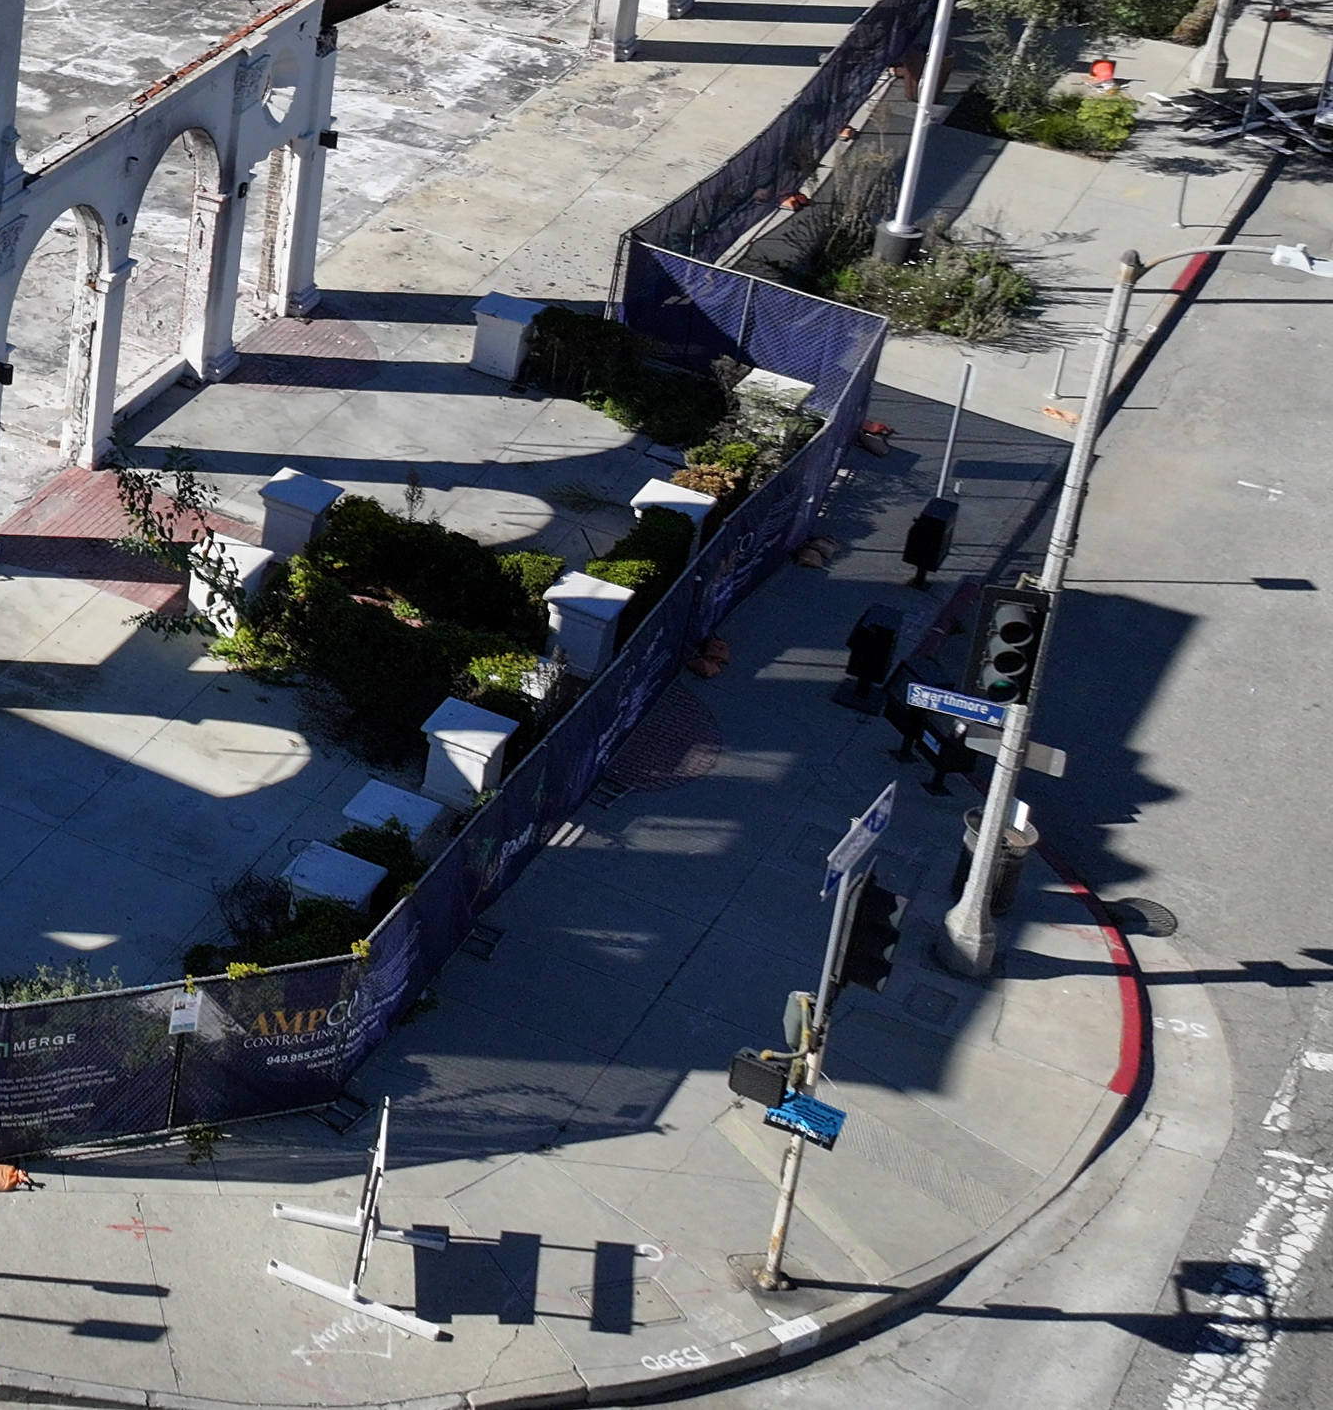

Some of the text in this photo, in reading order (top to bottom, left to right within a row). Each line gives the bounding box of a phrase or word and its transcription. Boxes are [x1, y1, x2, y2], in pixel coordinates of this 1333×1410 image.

[912, 686, 989, 714] Swarthmore
[13, 1033, 77, 1053] MERGE
[266, 1045, 336, 1066] 949.955.2255
